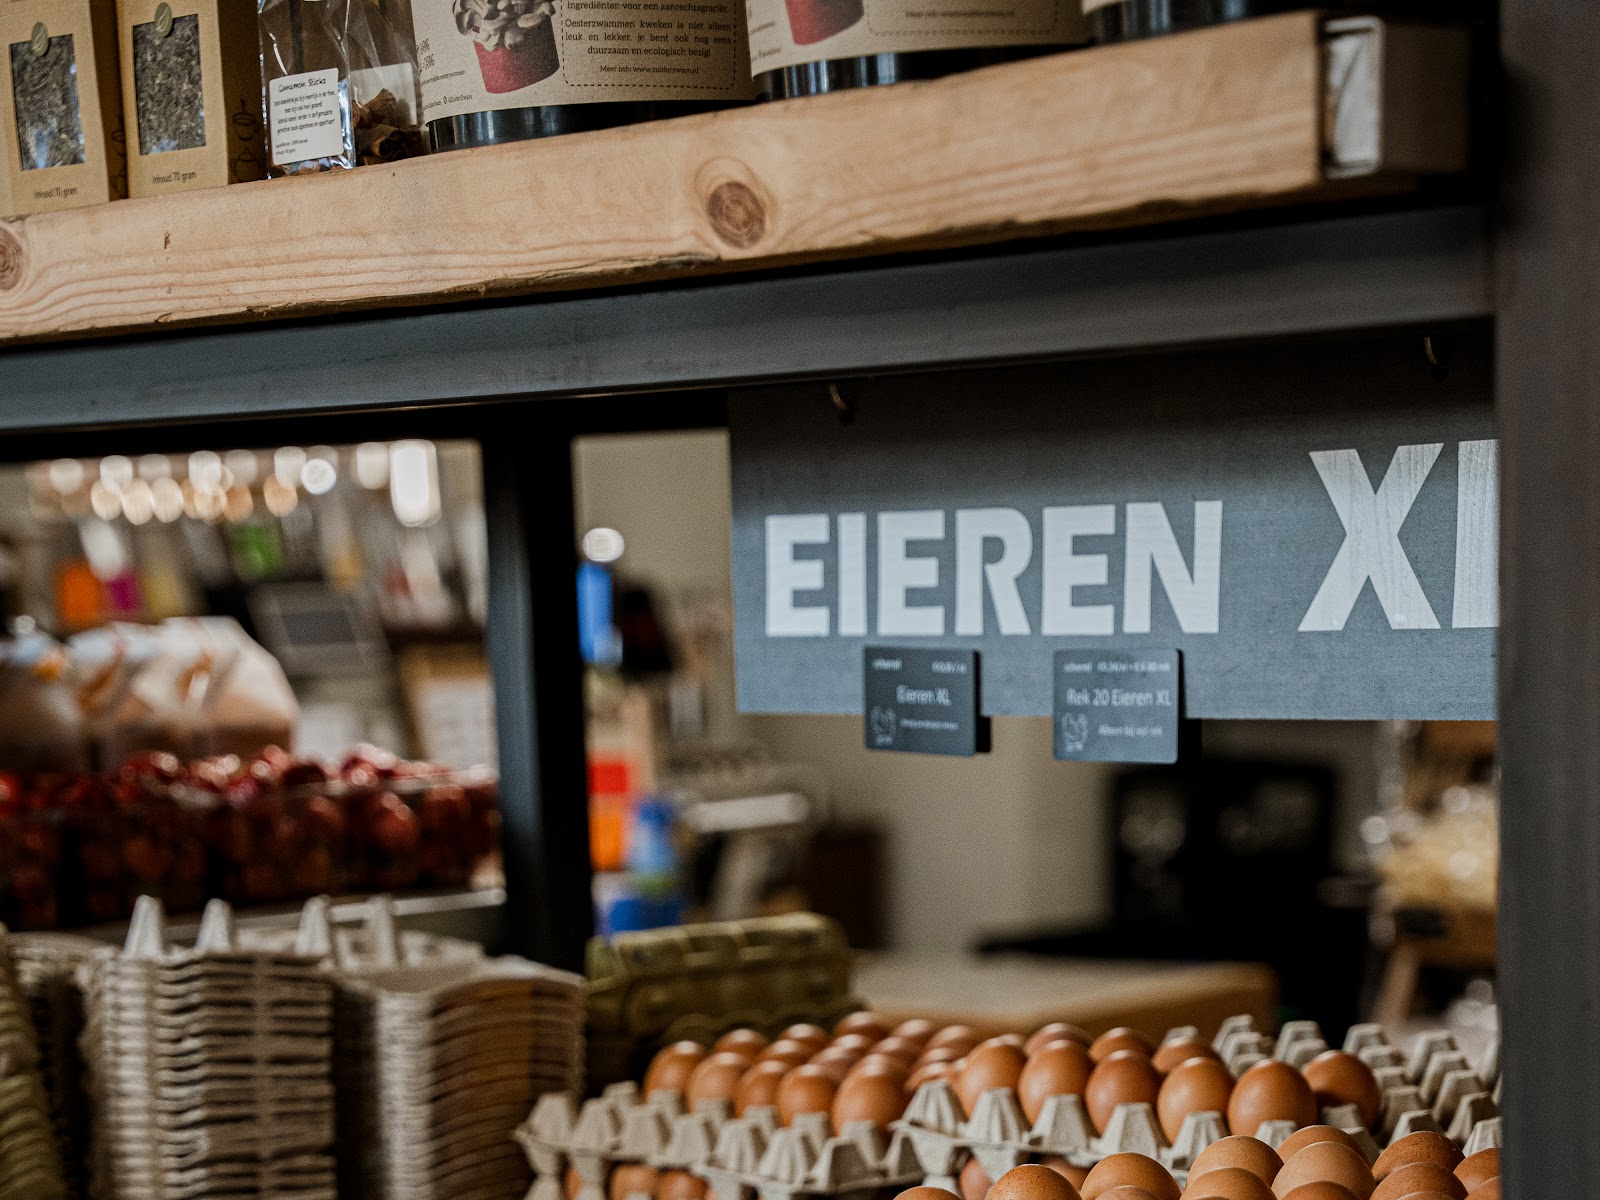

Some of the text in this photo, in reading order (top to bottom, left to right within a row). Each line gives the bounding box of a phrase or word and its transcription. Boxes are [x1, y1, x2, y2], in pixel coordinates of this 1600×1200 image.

[564, 19, 731, 31] Oesterzwammen kweken is niet alleen
[565, 33, 583, 41] leuk
[637, 34, 645, 43] je
[650, 34, 669, 42] bent
[674, 34, 690, 43] ook
[694, 36, 709, 45] nog
[587, 46, 630, 55] duurzaam
[643, 46, 687, 57] ecologisch
[600, 65, 617, 73] Meer
[618, 65, 632, 73] info
[308, 78, 327, 87] Sticks
[764, 499, 1224, 637] EIEREN
[1066, 687, 1172, 707] Rek 20 Eieren XL
